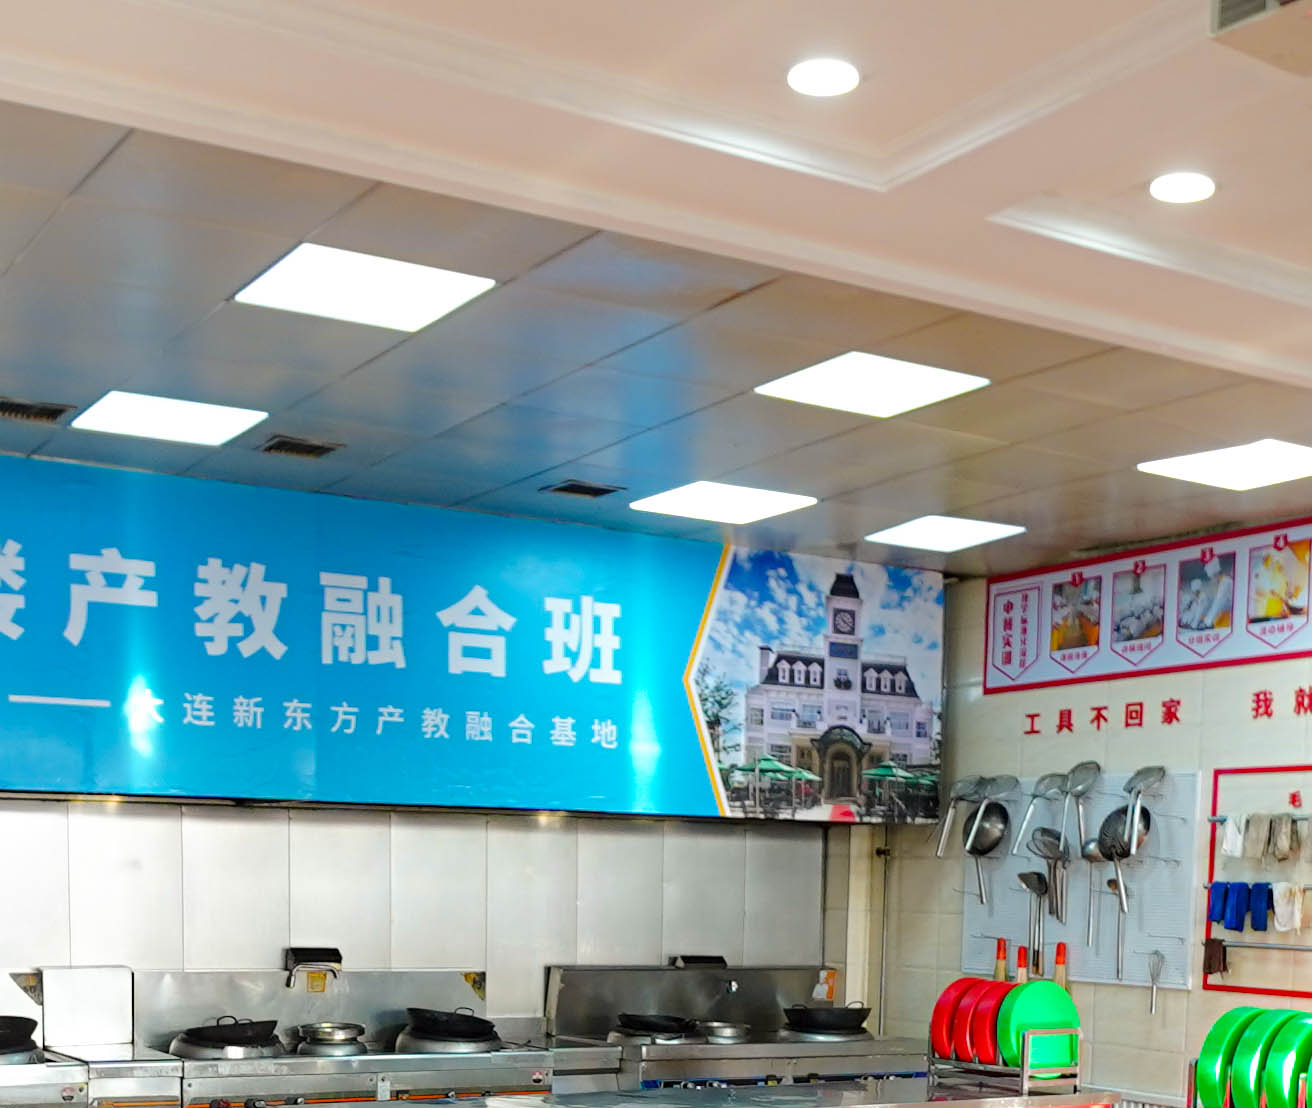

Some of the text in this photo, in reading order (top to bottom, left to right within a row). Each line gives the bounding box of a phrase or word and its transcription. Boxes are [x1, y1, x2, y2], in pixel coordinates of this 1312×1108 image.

[1023, 698, 1181, 735] 工具不回家
